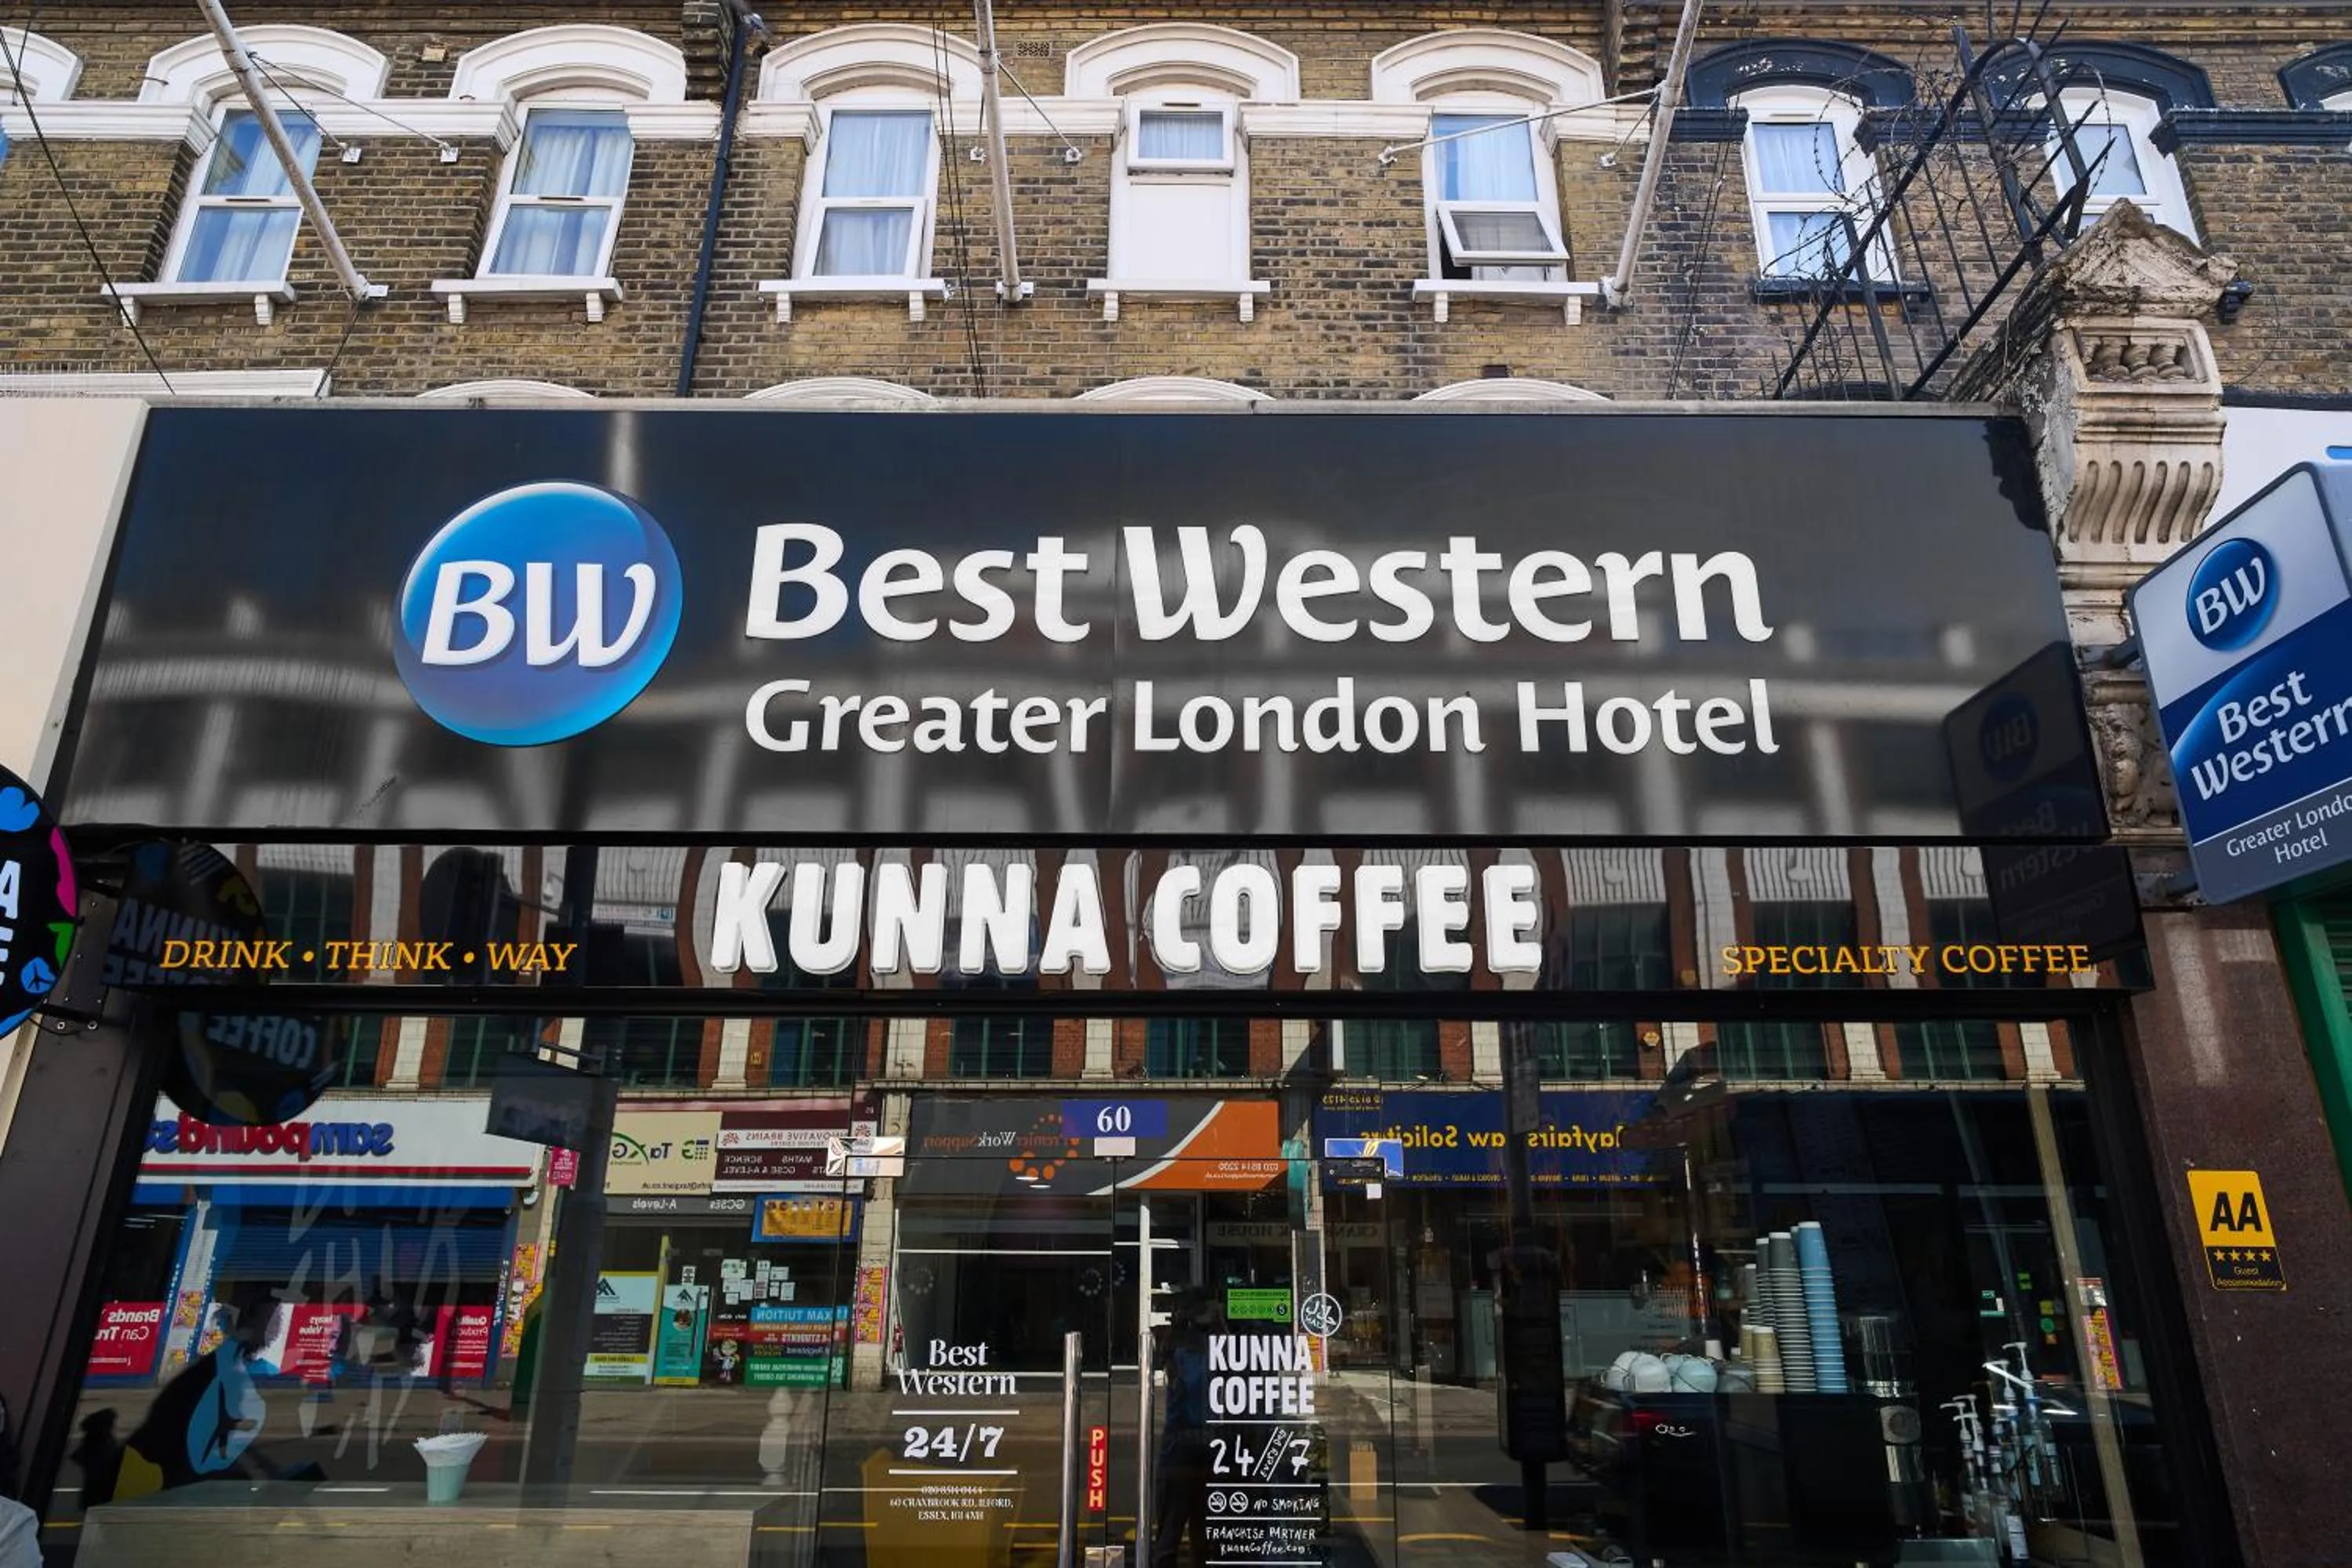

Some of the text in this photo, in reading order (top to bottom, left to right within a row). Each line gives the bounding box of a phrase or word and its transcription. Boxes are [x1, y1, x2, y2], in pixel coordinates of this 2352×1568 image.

[746, 523, 1773, 643] Best Western
[2194, 557, 2266, 636] BW
[420, 560, 657, 668] BW
[745, 677, 1780, 756] Greater London Hotel
[2216, 670, 2313, 745] Best
[2226, 819, 2292, 857] Greater
[2274, 827, 2329, 864] Hotel
[710, 861, 1543, 975] KUNNA COFFEE
[159, 941, 293, 969] DRINK
[325, 941, 454, 971] THINK
[487, 942, 579, 973] WAY
[1721, 946, 2092, 975] SPECIALTY COFFEE
[1098, 1105, 1131, 1132] 60
[2209, 1192, 2263, 1232] AA
[928, 1338, 989, 1367] Best
[1208, 1334, 1313, 1371] KUNNA
[897, 1367, 1017, 1396] Western
[1208, 1376, 1315, 1414] COFFEE
[904, 1423, 1004, 1462] 24/7
[1088, 1428, 1104, 1508] PUSH
[902, 1497, 960, 1508] CRANBROOK
[1254, 1498, 1320, 1512] NO SMOKING
[1206, 1526, 1316, 1541] FRANCHISE PARTNER
